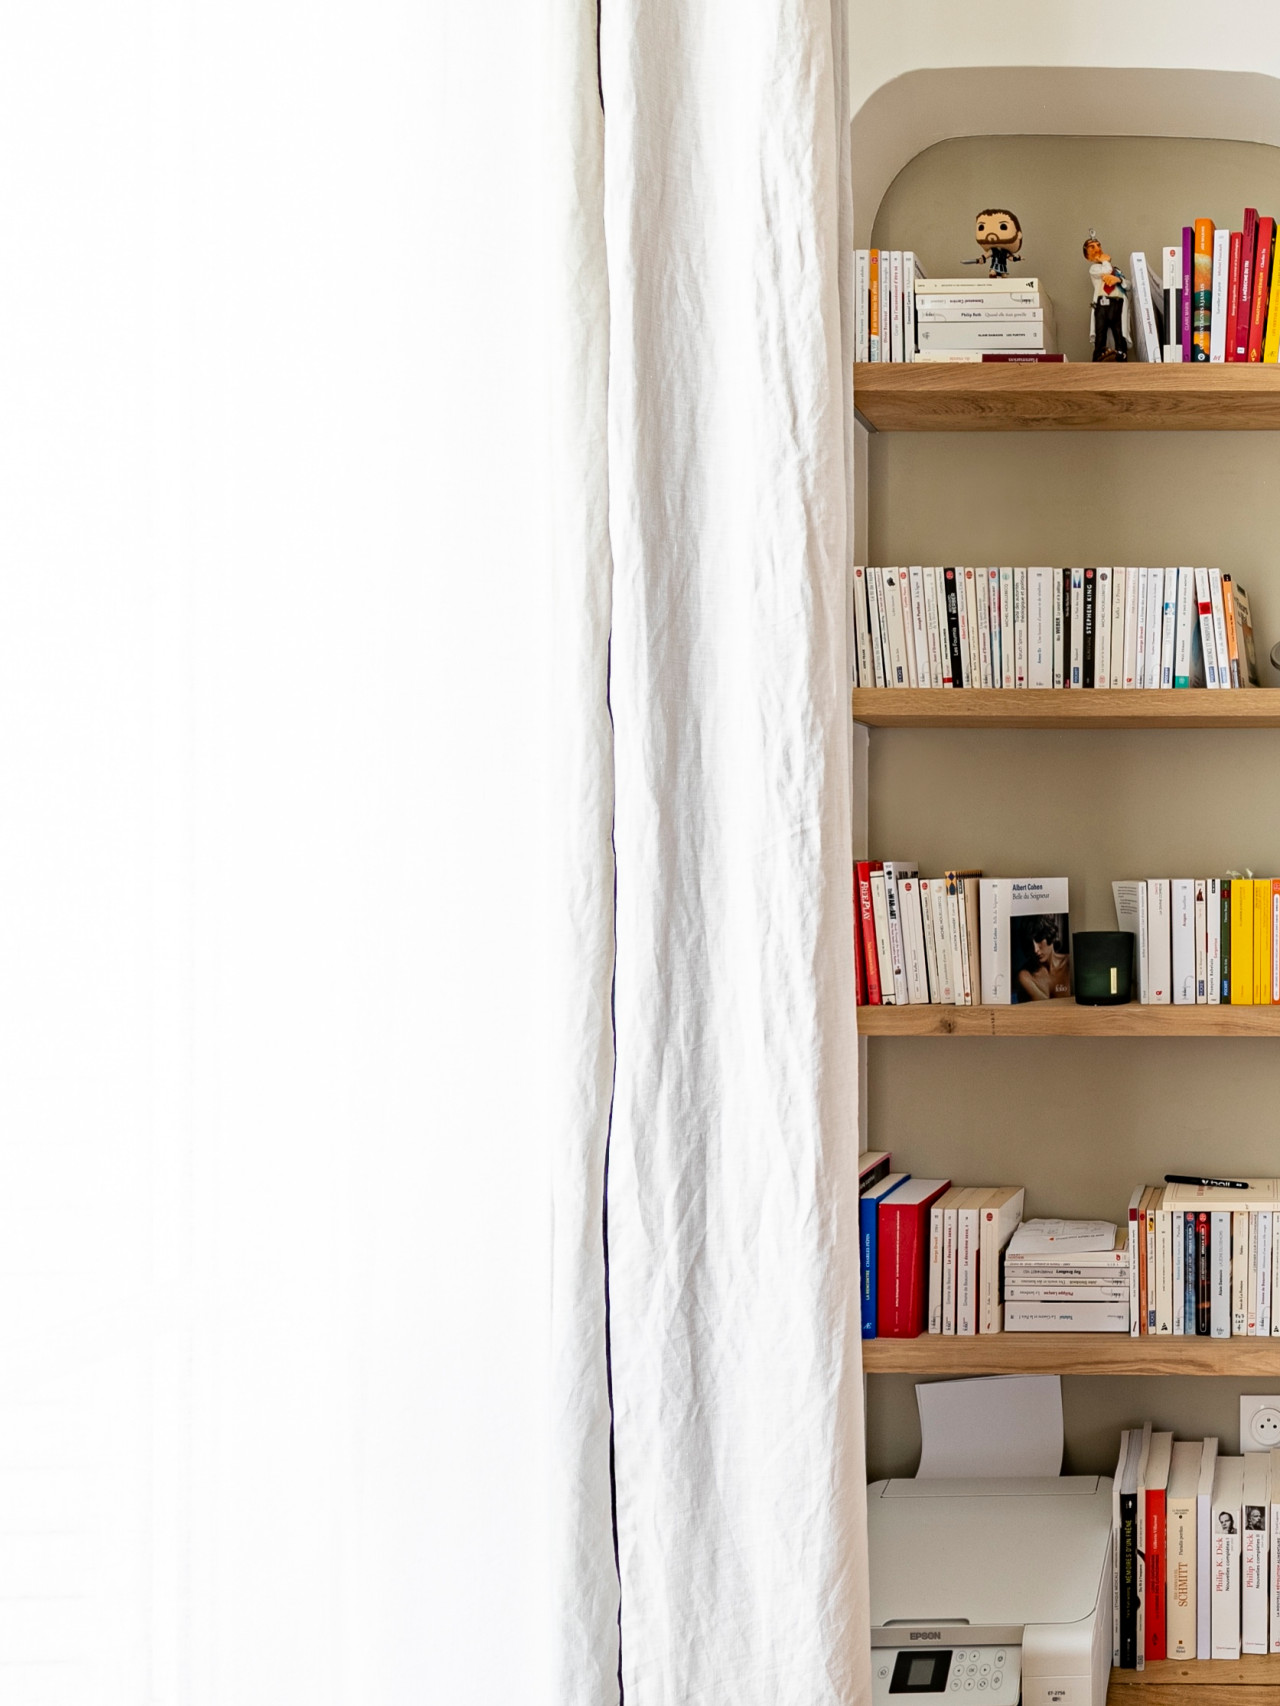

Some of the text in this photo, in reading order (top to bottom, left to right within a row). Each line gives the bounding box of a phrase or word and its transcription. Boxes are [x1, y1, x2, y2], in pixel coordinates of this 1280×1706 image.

[1030, 892, 1050, 900] Seigneur
[1055, 984, 1068, 992] folio
[1124, 1520, 1133, 1584] MÉMOIRES D'UN FRÊNE
[1215, 1537, 1223, 1555] Dick
[1216, 1558, 1223, 1568] K.
[1246, 1534, 1254, 1588] Philip K. Dick
[1178, 1562, 1188, 1607] SCHMITT
[910, 1632, 941, 1640] EPSON
